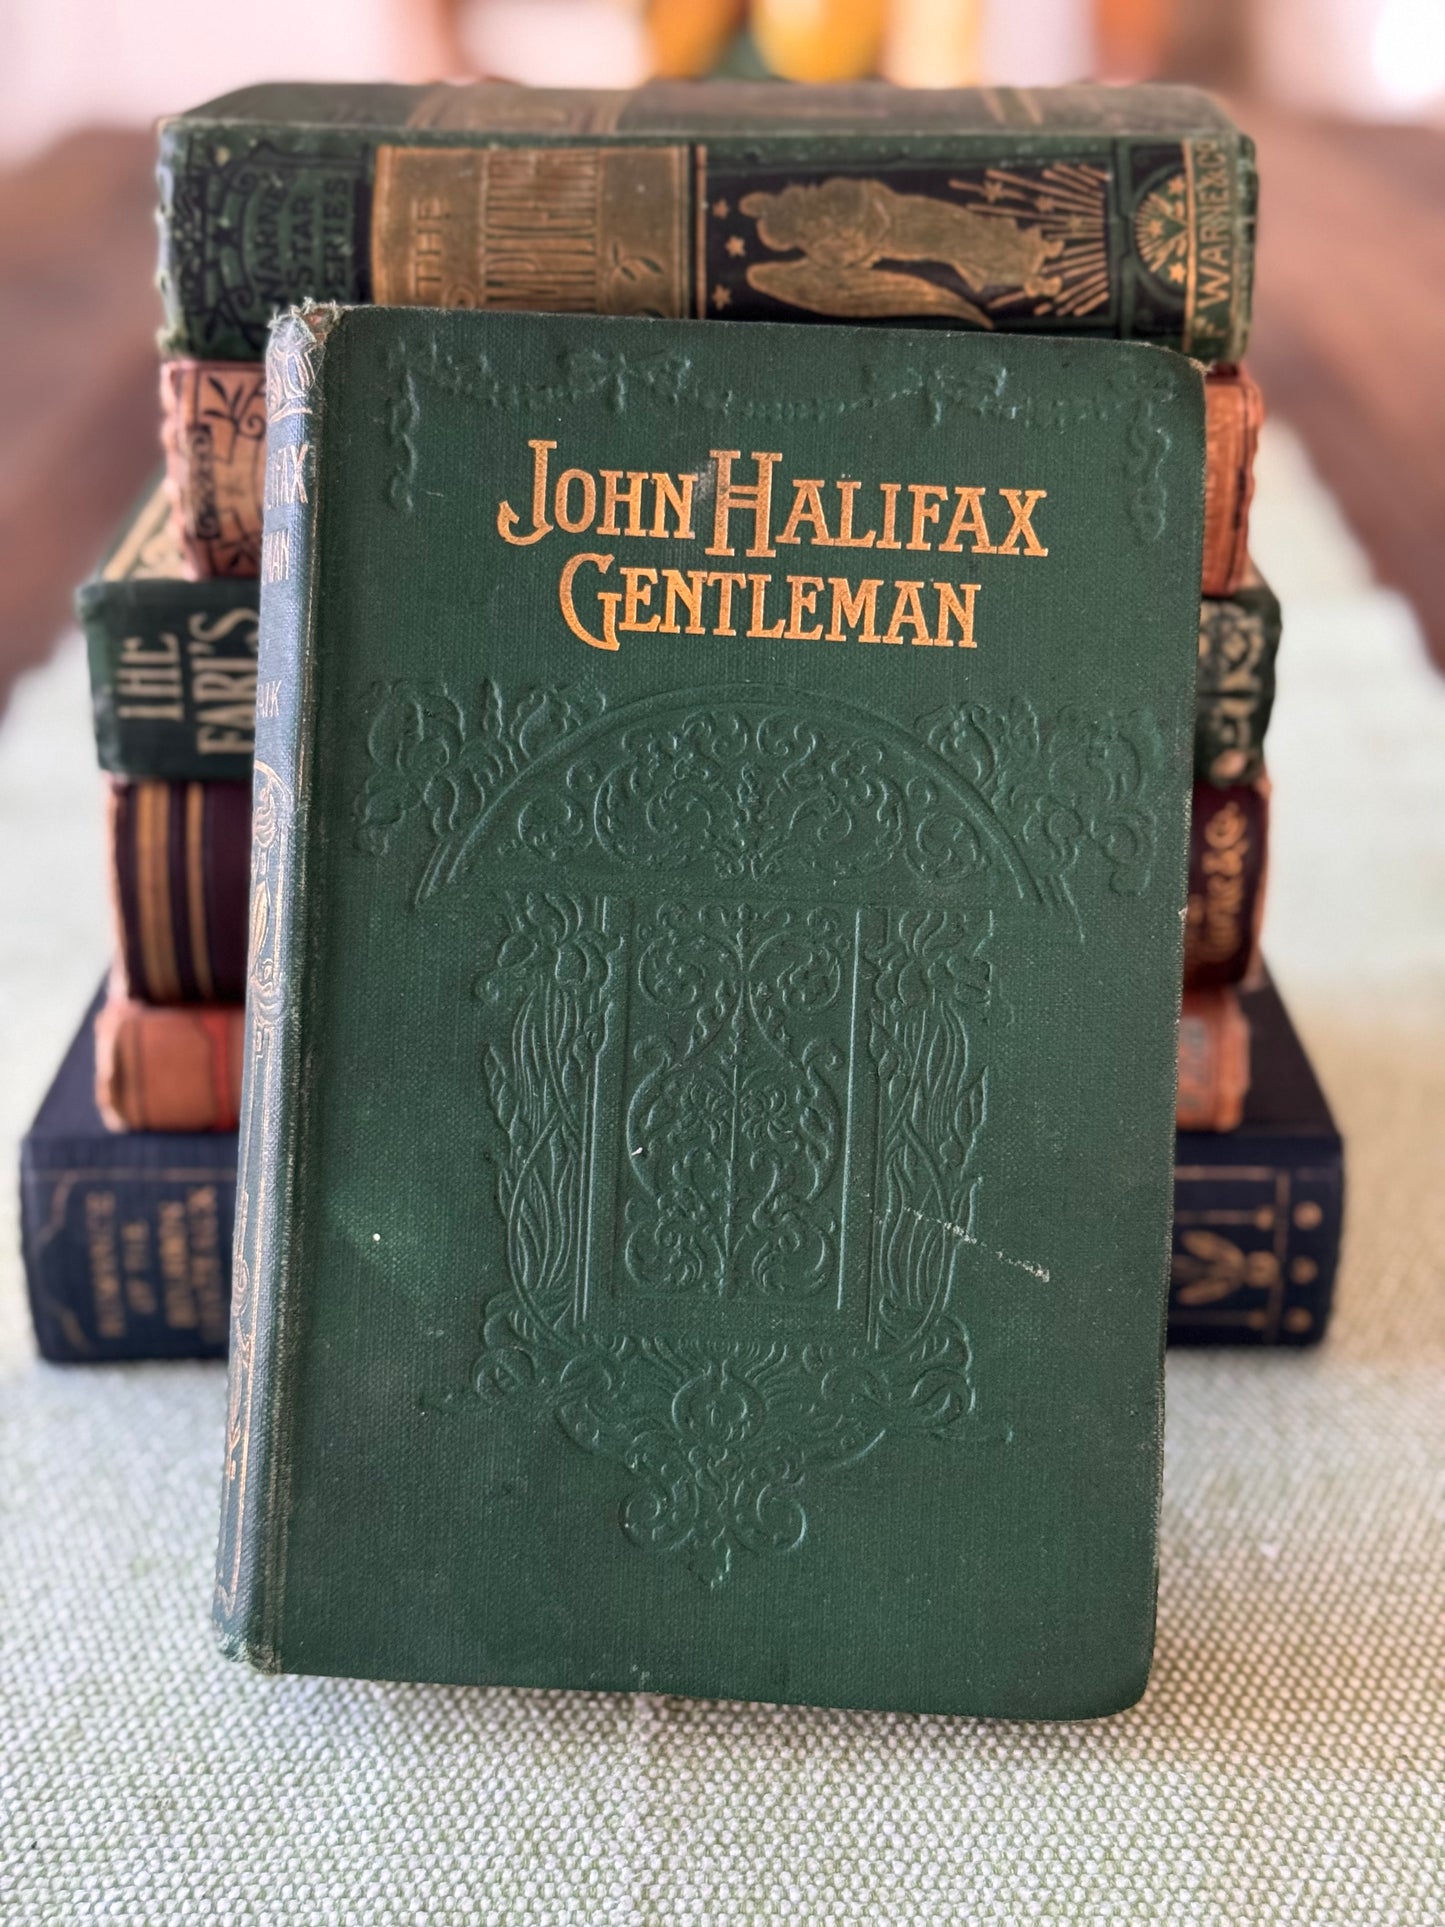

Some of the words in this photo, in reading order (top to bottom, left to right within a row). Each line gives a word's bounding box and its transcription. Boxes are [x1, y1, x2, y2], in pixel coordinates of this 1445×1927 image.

[497, 439, 698, 546] JOHN
[705, 449, 1049, 557] HALIFAX
[559, 552, 982, 651] GENTLEMAN
